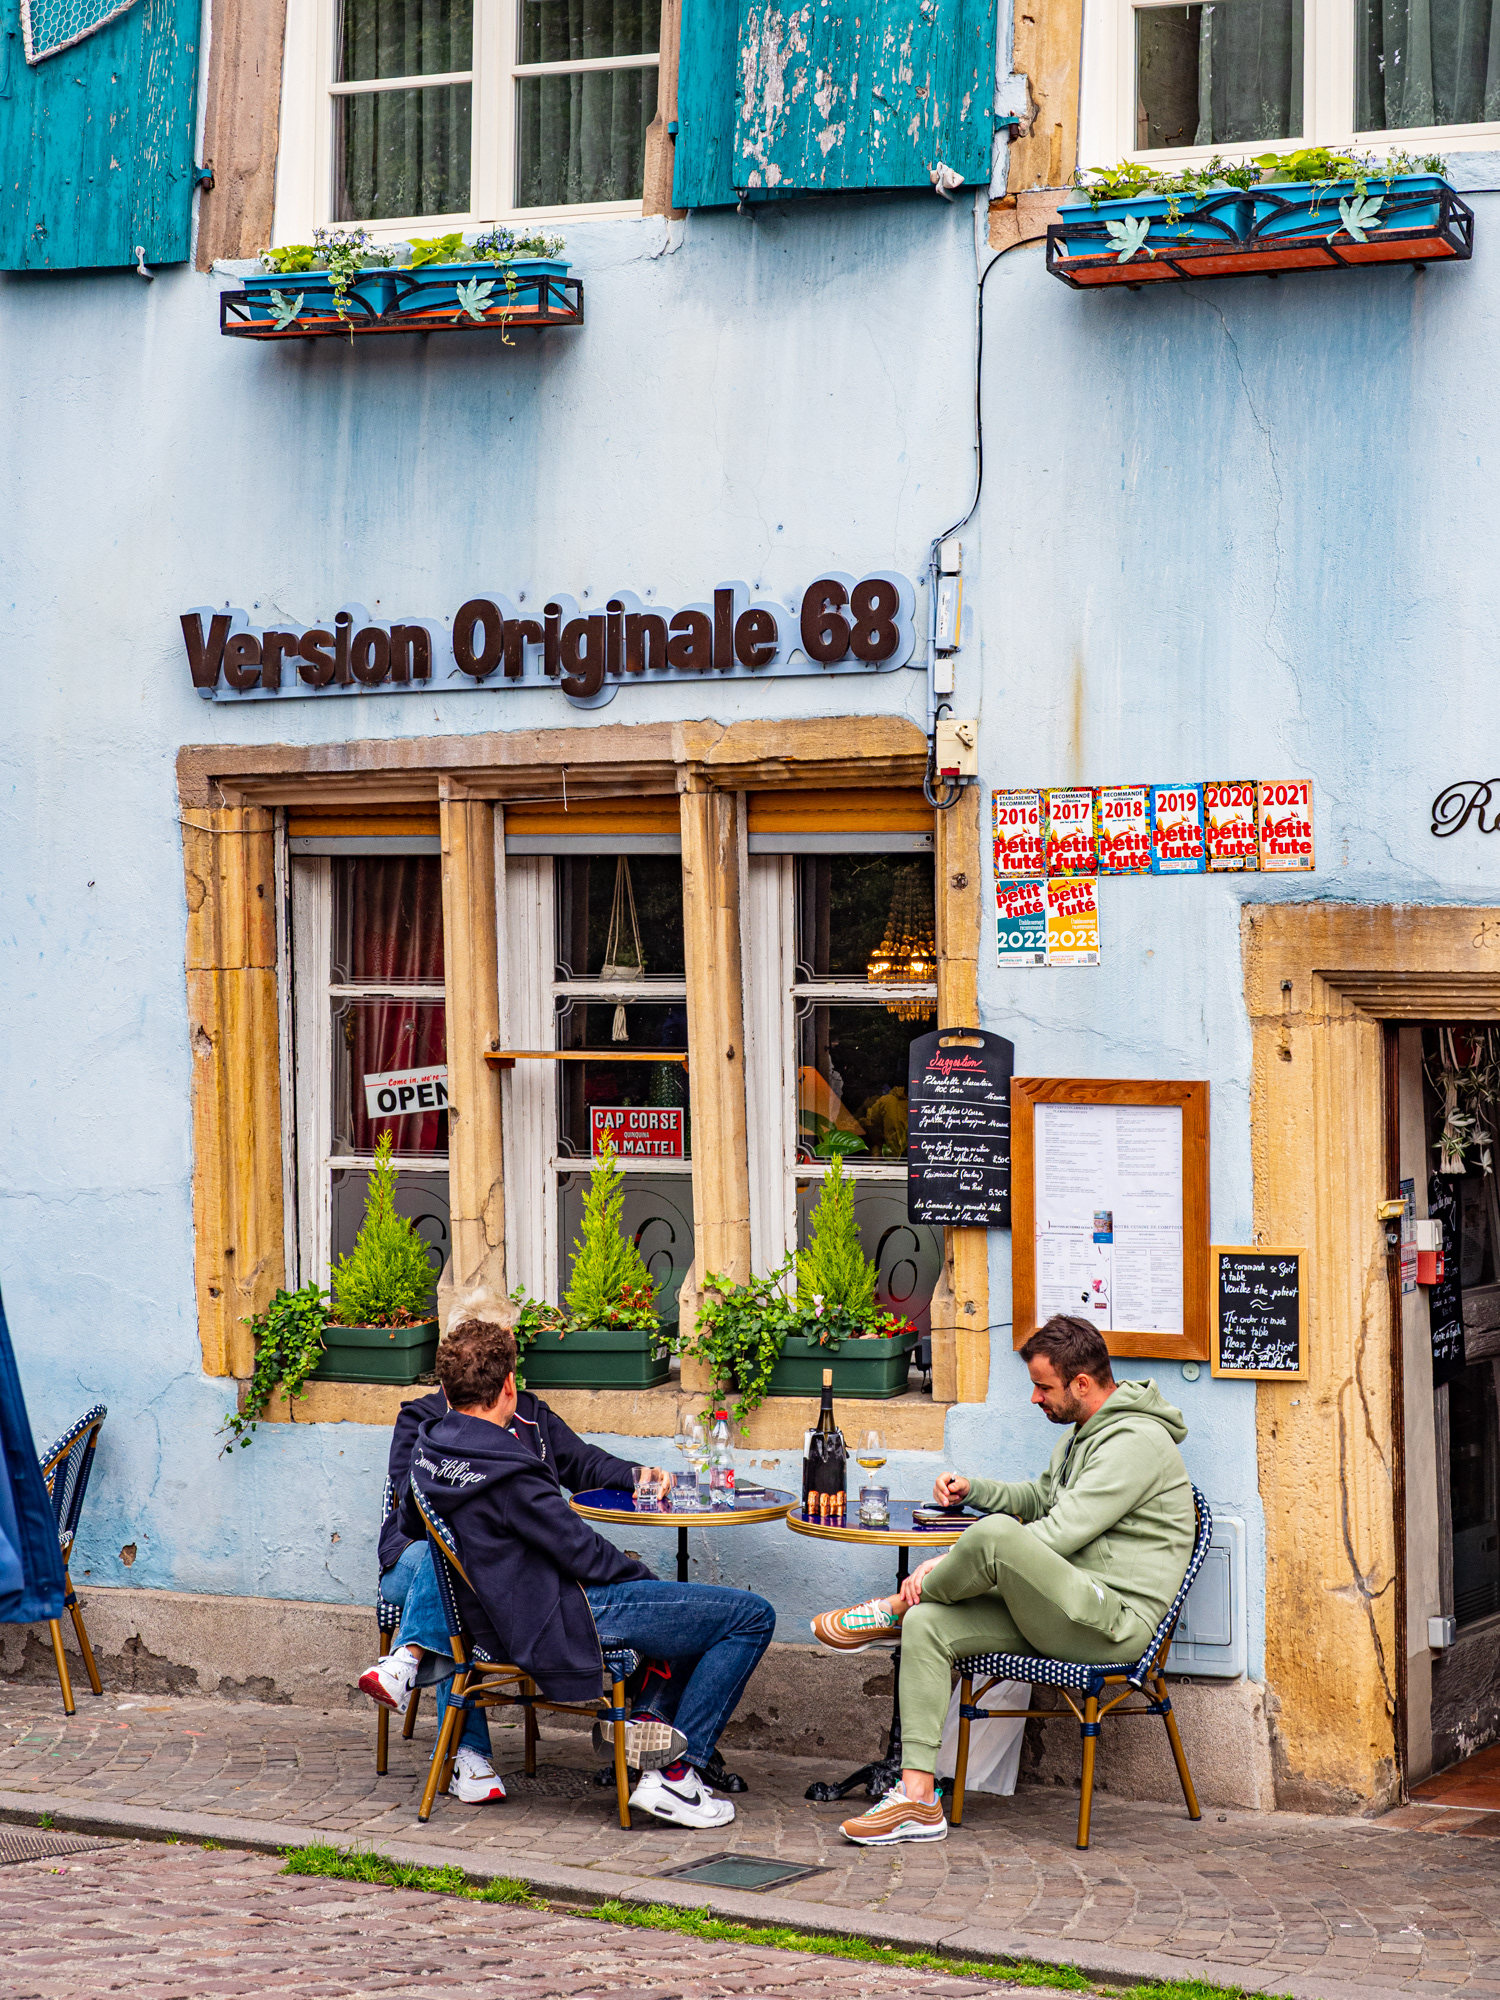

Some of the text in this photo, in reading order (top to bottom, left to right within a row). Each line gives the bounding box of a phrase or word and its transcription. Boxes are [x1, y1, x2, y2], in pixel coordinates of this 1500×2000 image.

[179, 611, 432, 689] Version
[452, 588, 778, 698] Originale
[799, 579, 901, 664] 68
[1158, 793, 1196, 812] 2019
[1207, 787, 1254, 807] 2020
[1263, 785, 1307, 805] 2021
[999, 808, 1038, 825] 2016
[1052, 804, 1090, 820] 2017
[1105, 801, 1142, 818] 2018
[1153, 825, 1202, 846] petit
[1207, 822, 1256, 843] petit
[1262, 821, 1311, 842] petit
[994, 836, 1042, 857] petit
[1047, 836, 1097, 857] petit
[1100, 834, 1150, 855] petit
[1002, 853, 1043, 869] futé
[1055, 853, 1098, 869] futé
[1108, 851, 1151, 867] futé
[996, 884, 1041, 908] petit
[1048, 883, 1092, 907] petit
[1006, 899, 1044, 918] futé
[1057, 898, 1095, 917] futé
[998, 931, 1046, 948] 2022
[1049, 930, 1098, 947] 2023
[930, 1050, 983, 1075] Suggestion
[388, 1074, 439, 1086] Come in, we're
[595, 1111, 678, 1130] CAP CORSE
[624, 1131, 650, 1139] QUINQUINA
[1228, 1270, 1247, 1281] table
[1224, 1281, 1299, 1300] Veuillez être patient
[1223, 1310, 1238, 1323] The
[1239, 1314, 1258, 1323] order
[1270, 1317, 1287, 1326] made
[1223, 1322, 1269, 1337] at the table
[1225, 1335, 1298, 1352] Please be patient
[437, 1459, 487, 1488] Hilfiger
